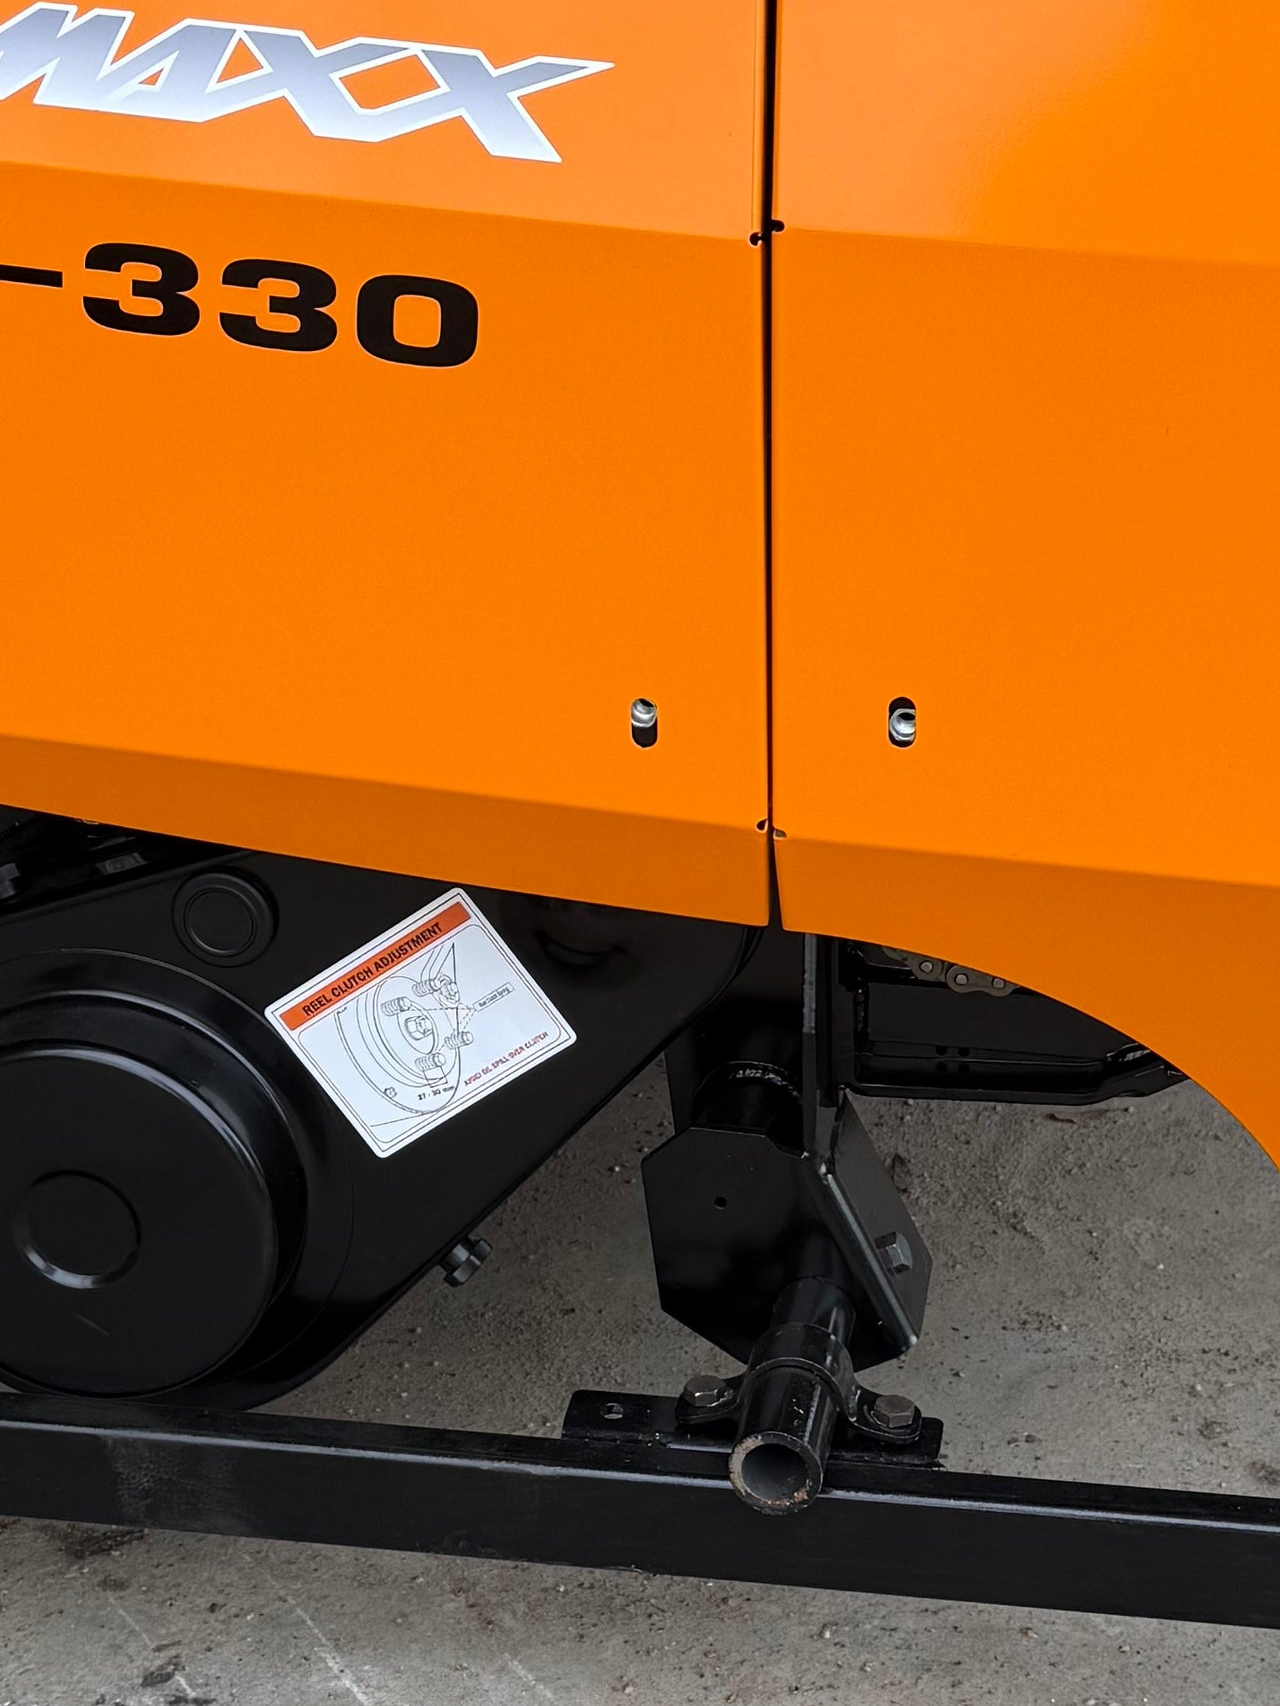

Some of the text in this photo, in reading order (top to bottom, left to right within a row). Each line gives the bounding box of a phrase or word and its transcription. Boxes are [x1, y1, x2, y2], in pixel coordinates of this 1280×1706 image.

[302, 922, 443, 1017] REEL CLUTCH ADJUSTMENT
